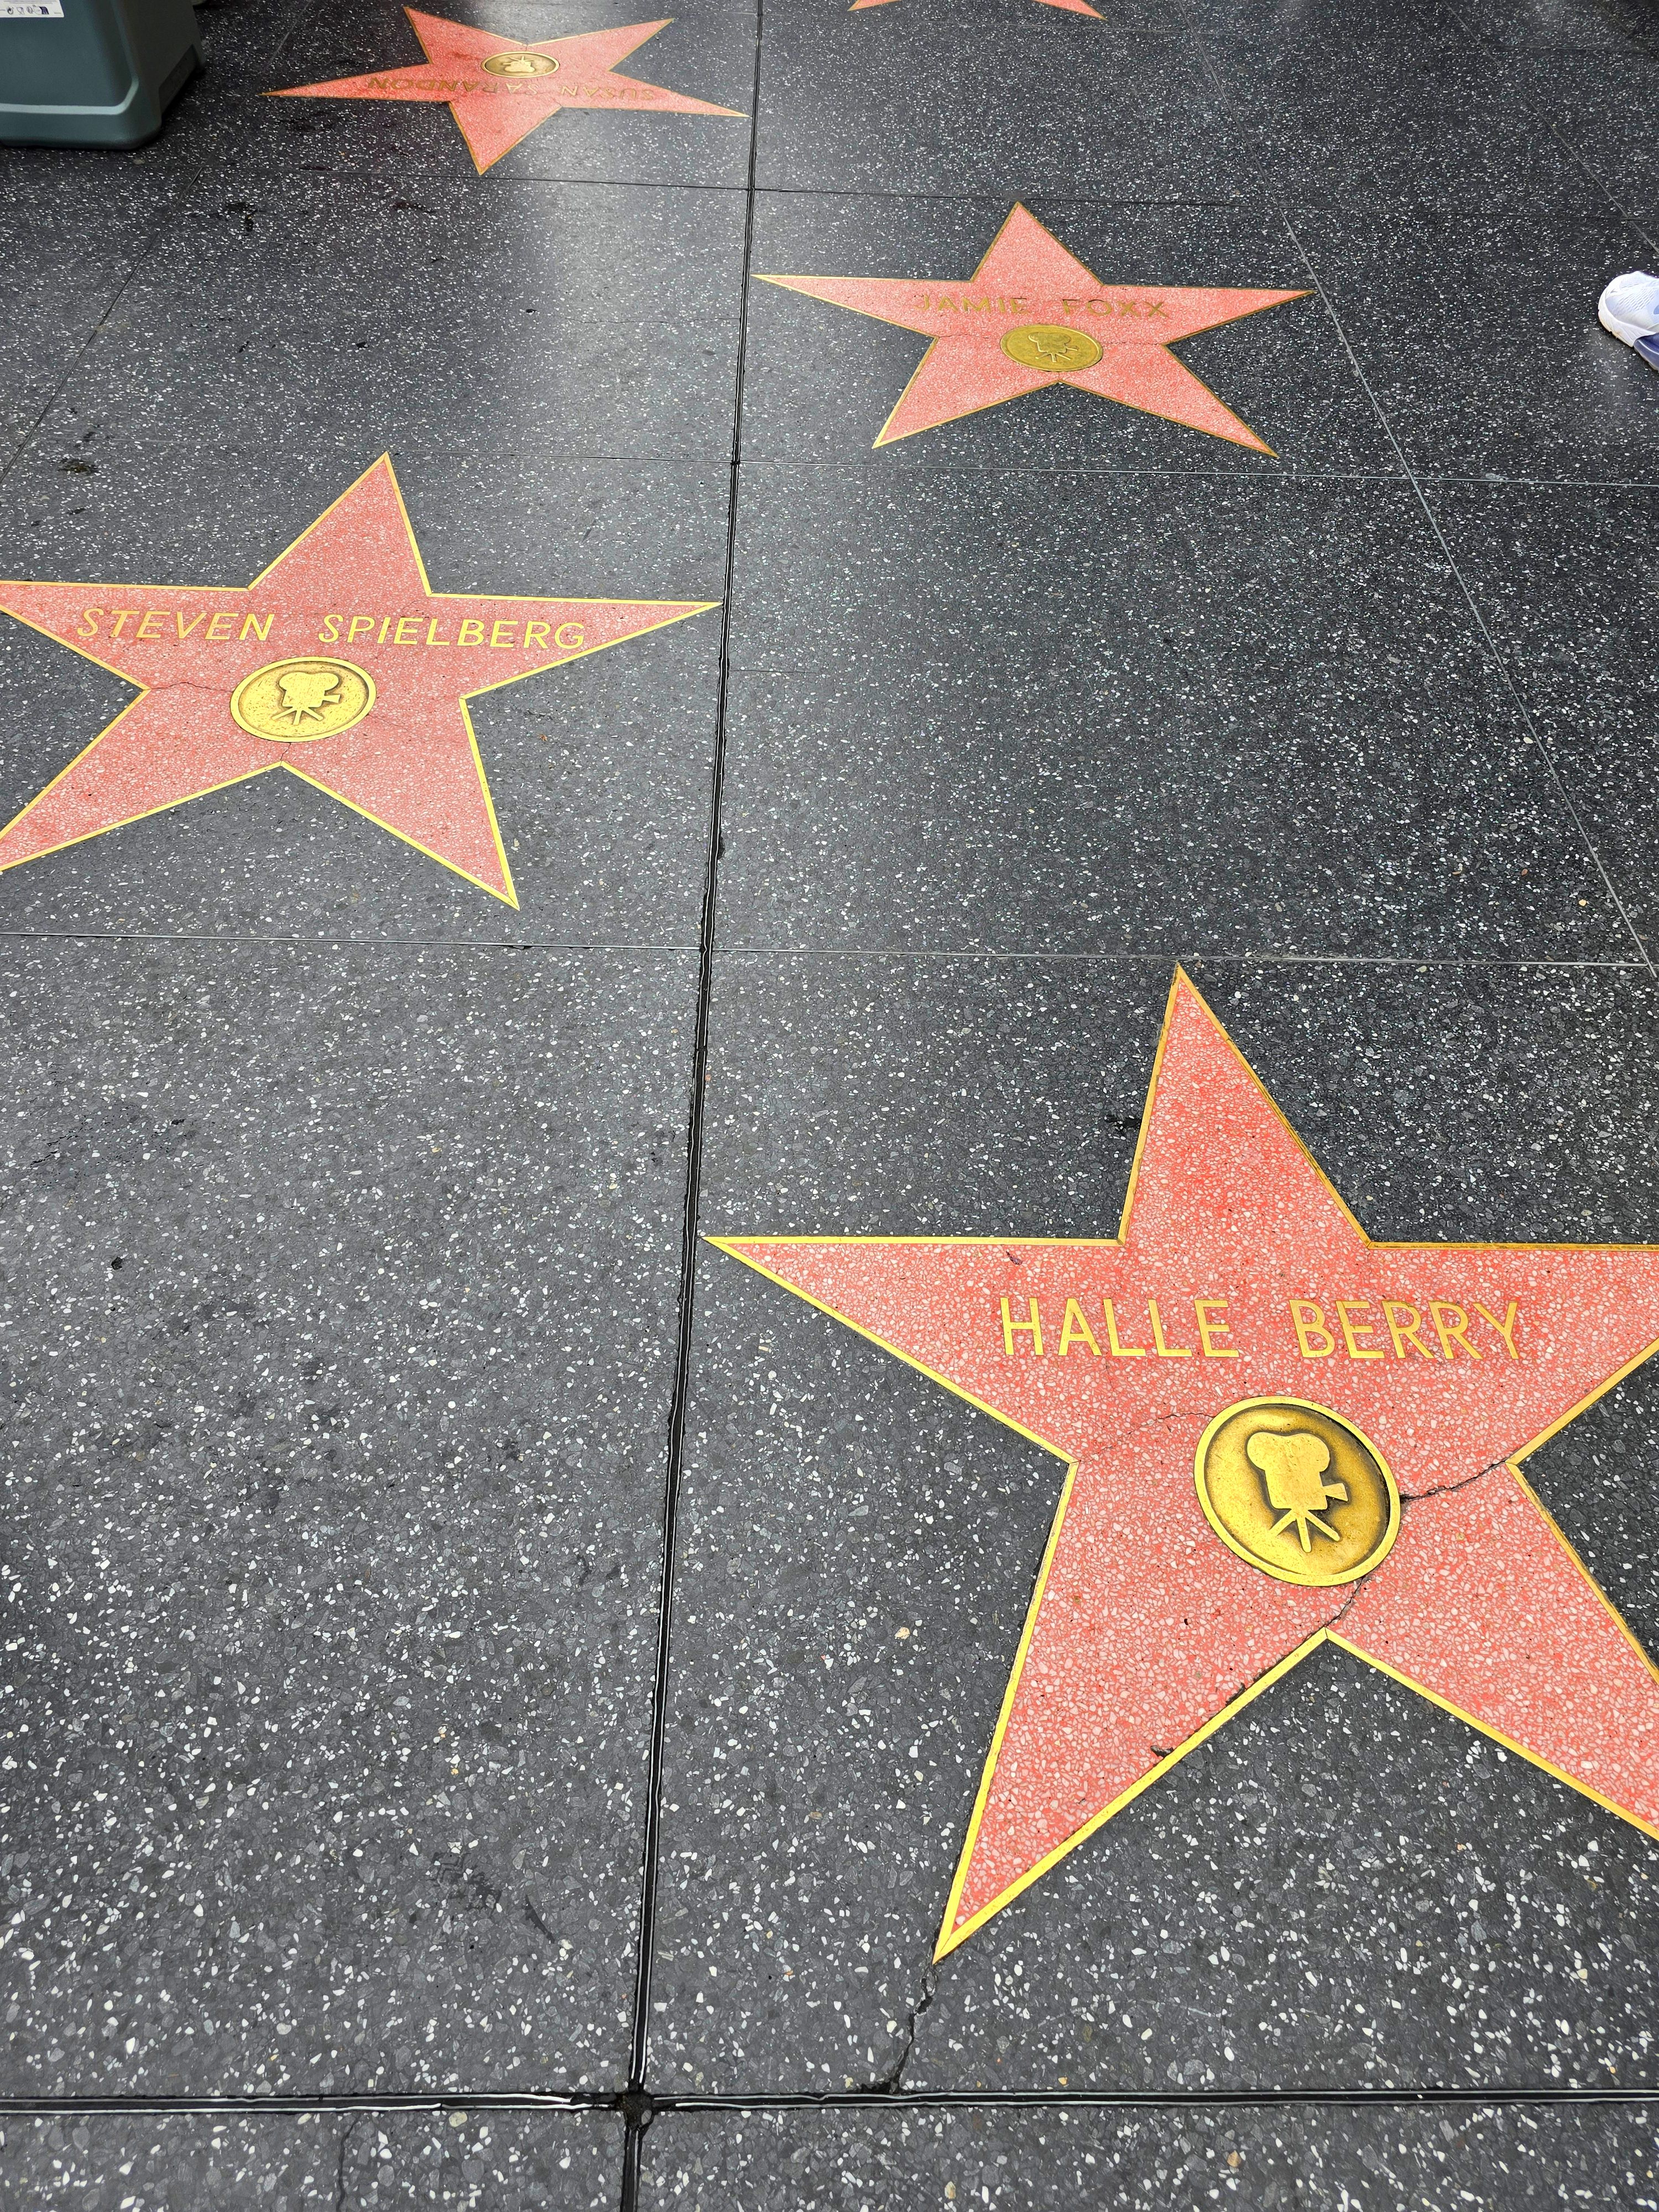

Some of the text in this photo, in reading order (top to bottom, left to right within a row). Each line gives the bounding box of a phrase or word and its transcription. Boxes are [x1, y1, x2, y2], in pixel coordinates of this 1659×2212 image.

[367, 77, 654, 100] SUSAN SARANDON
[914, 294, 1170, 318] JAMIE FOXX
[76, 607, 585, 650] STEVEN SPIELBERG
[1000, 1297, 1520, 1360] HALLE BERRY
